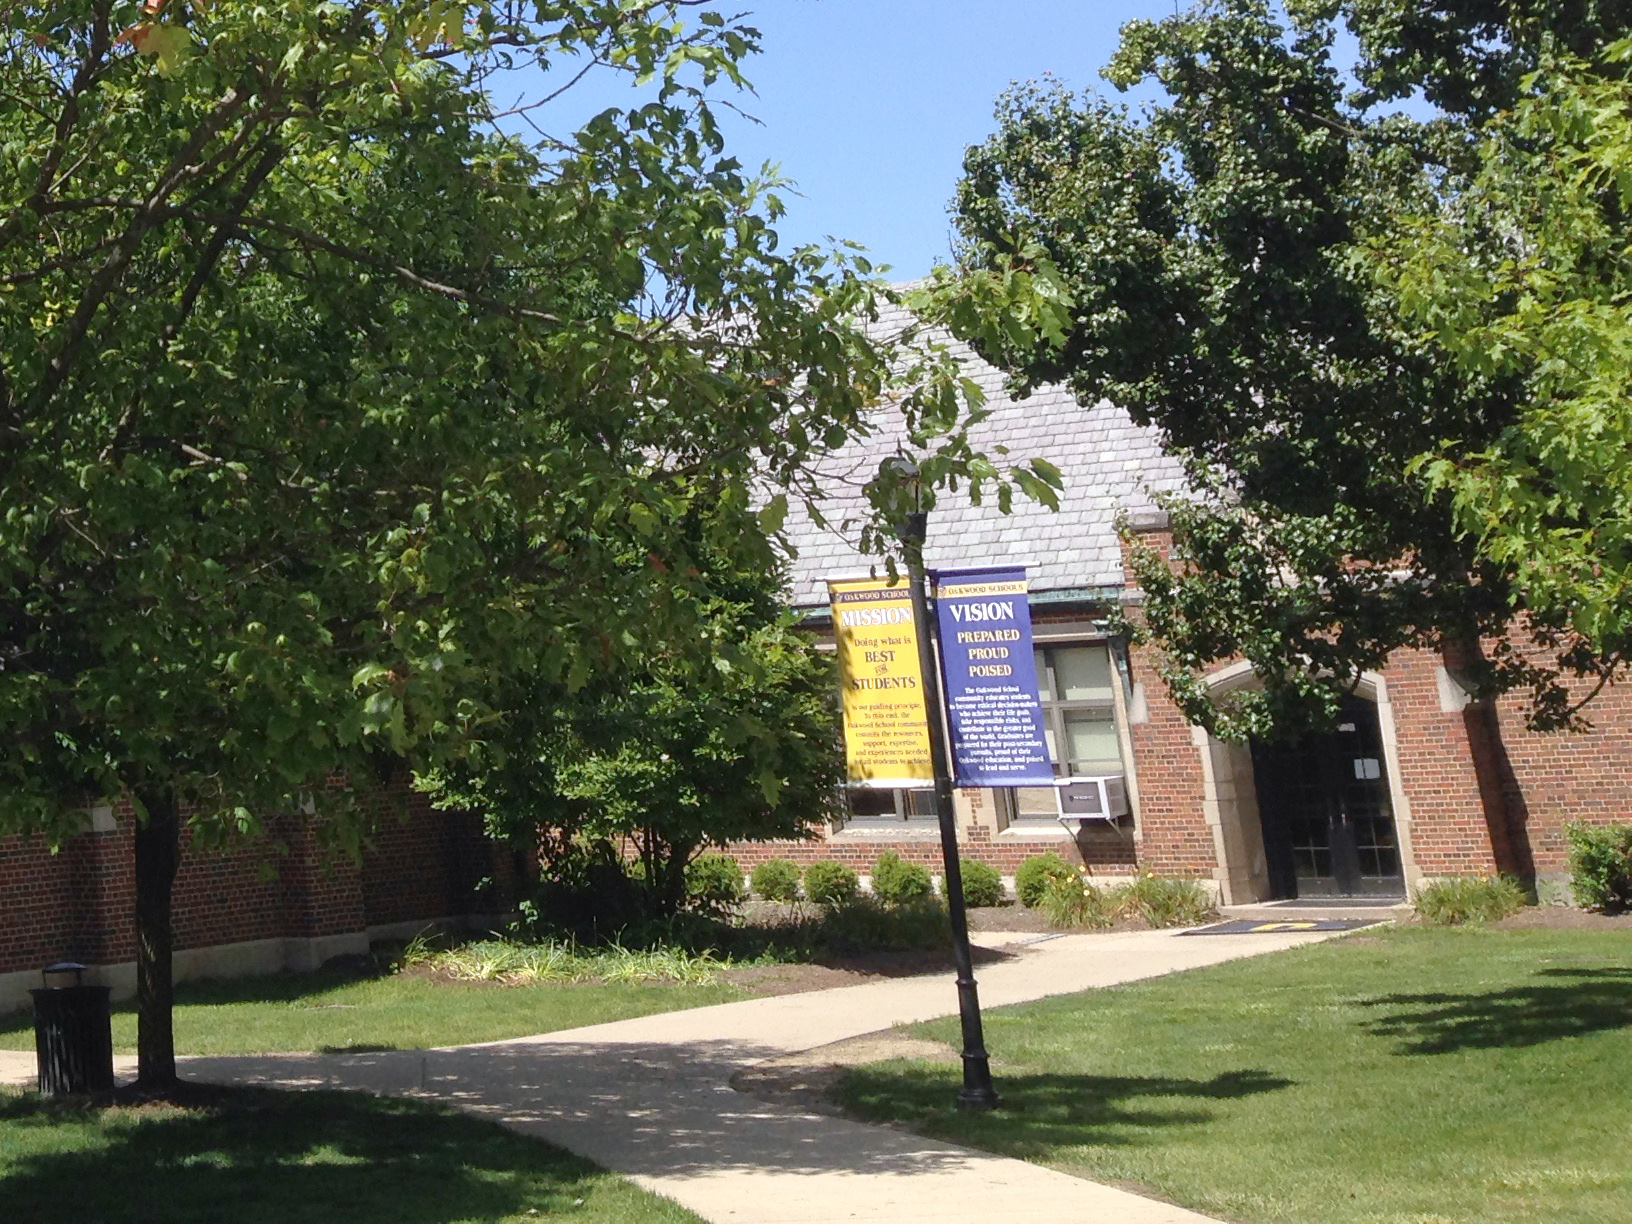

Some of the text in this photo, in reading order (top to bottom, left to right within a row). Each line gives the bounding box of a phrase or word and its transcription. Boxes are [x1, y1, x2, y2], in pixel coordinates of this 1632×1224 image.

[841, 607, 911, 626] MISSION
[949, 602, 1013, 622] VISION
[957, 629, 1020, 644] PREPARED
[865, 651, 895, 662] BEST
[968, 647, 1009, 660] PROUD
[969, 665, 1012, 677] POISED
[852, 677, 916, 690] STUDENTS
